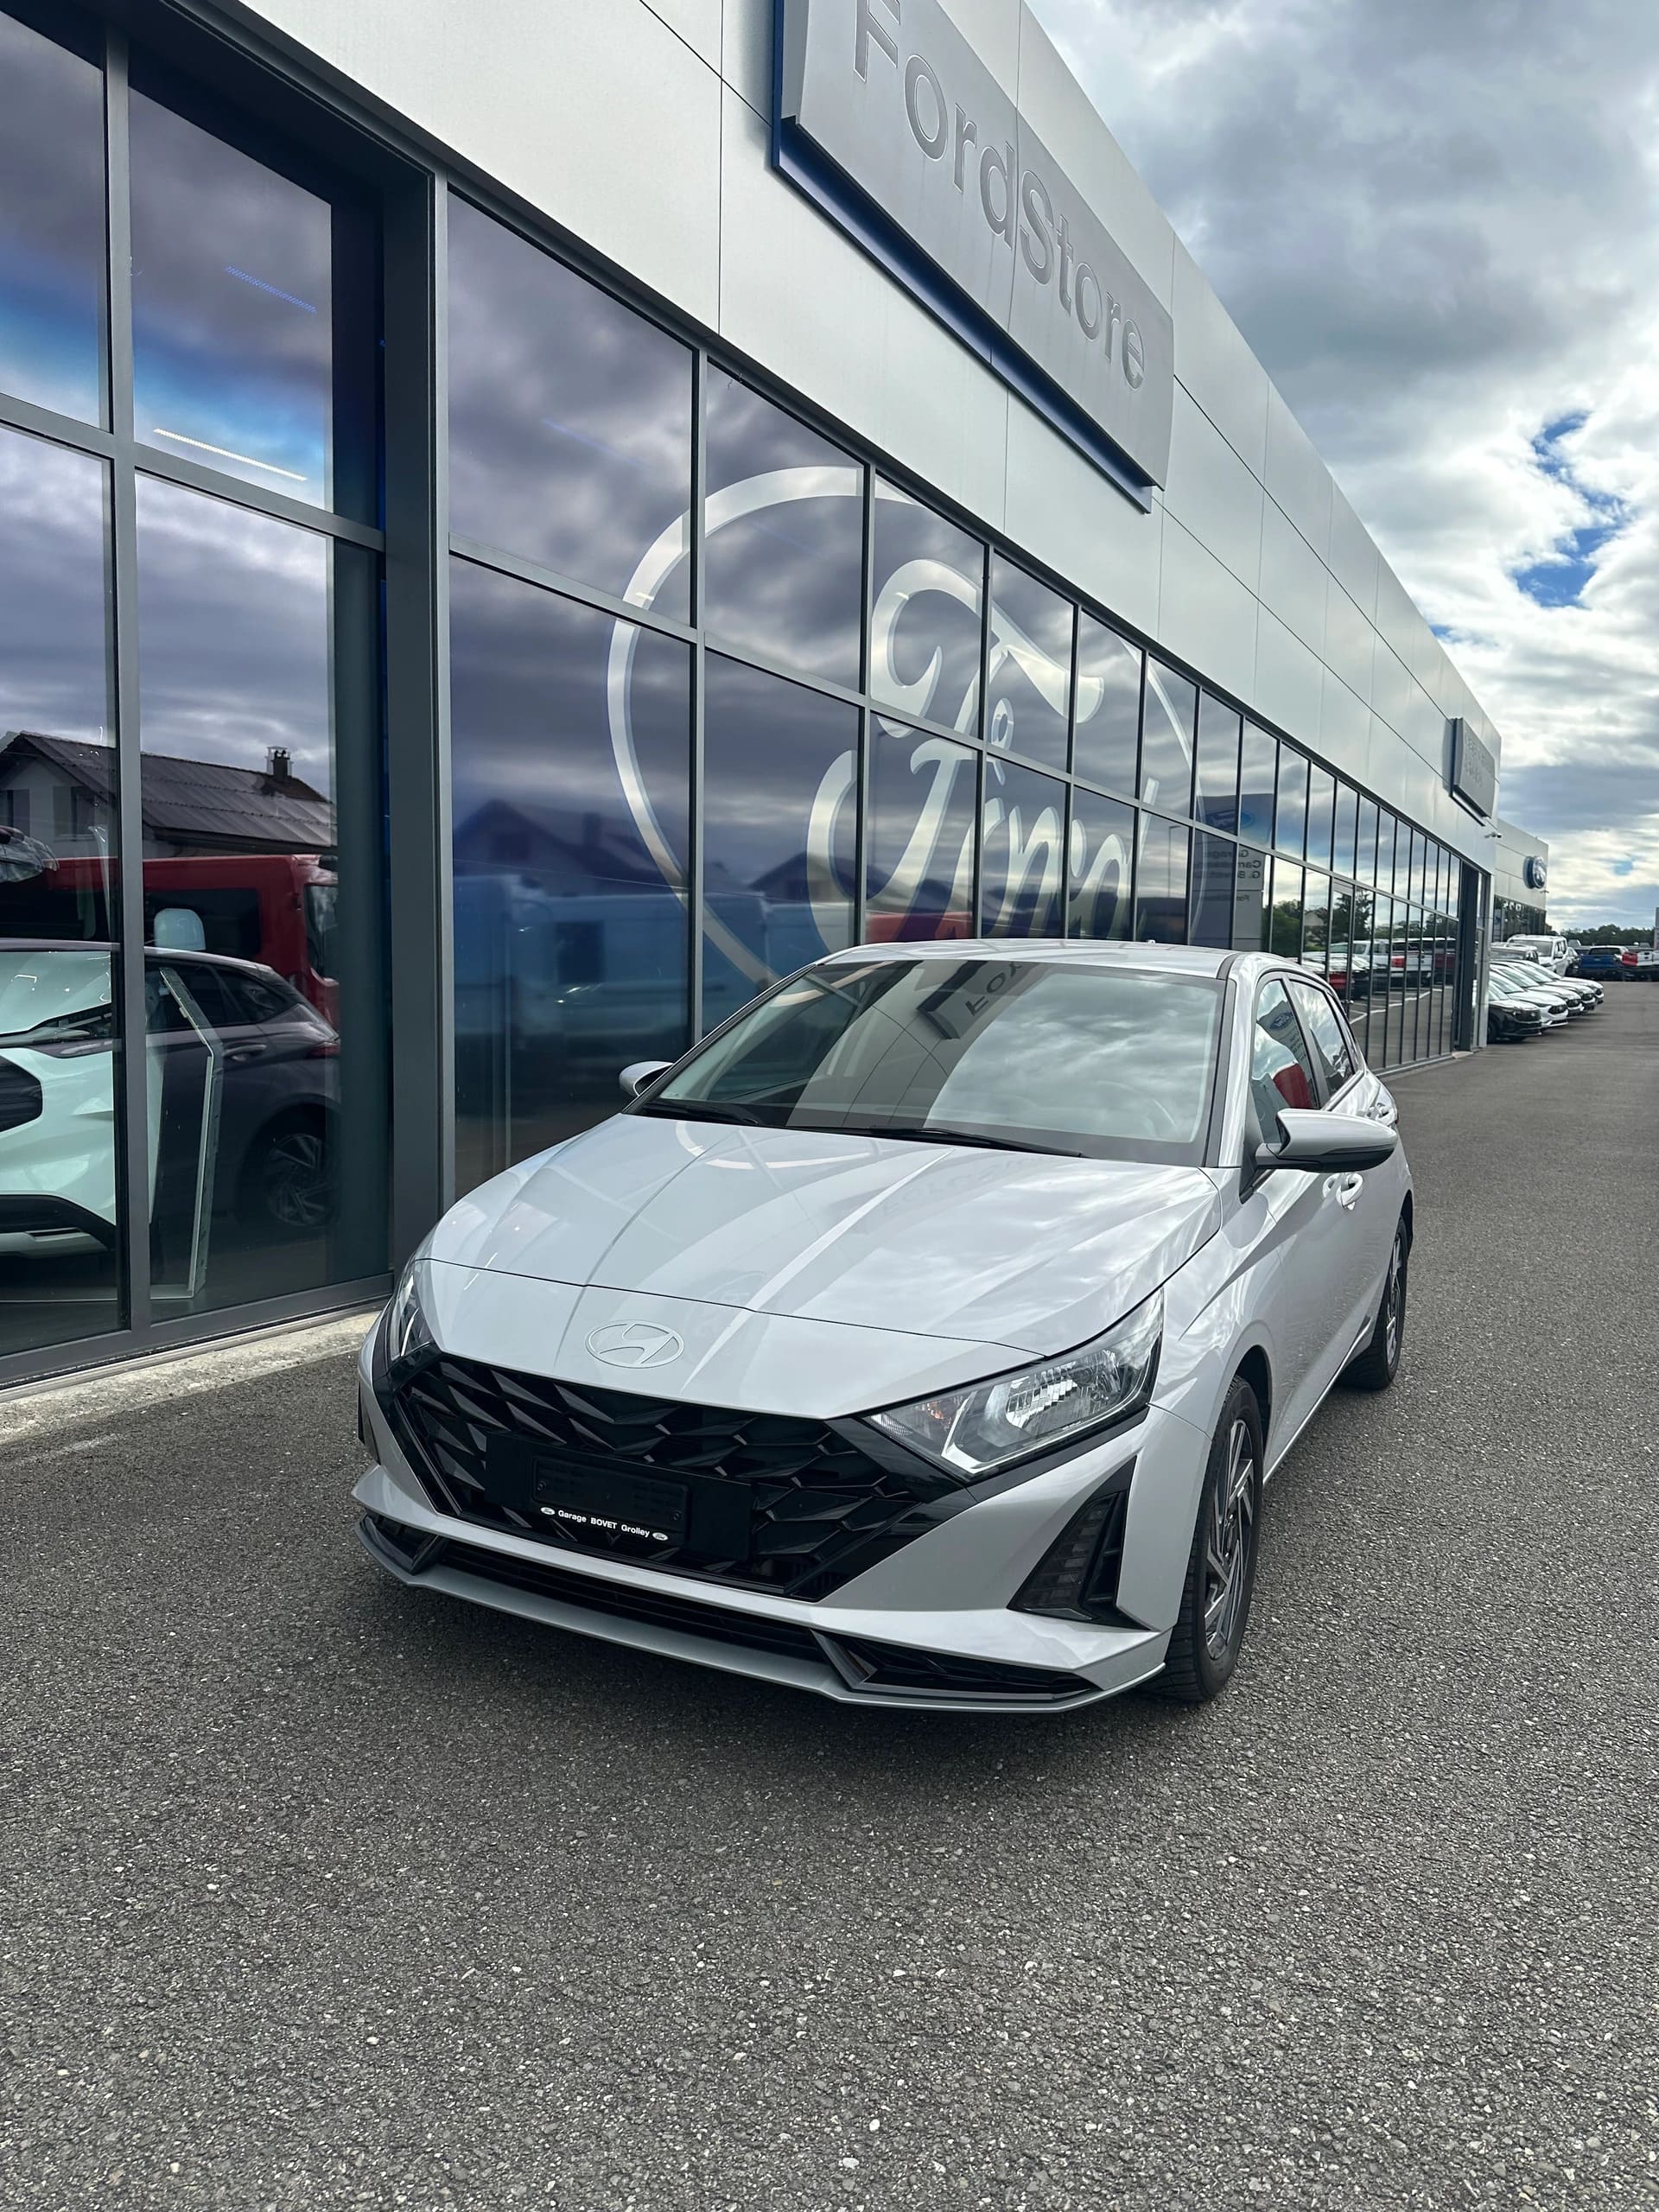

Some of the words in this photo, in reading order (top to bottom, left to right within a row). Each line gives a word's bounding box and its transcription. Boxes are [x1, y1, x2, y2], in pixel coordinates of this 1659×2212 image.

[853, 0, 1146, 391] FordStore
[557, 1510, 588, 1523] Garage
[590, 1516, 618, 1529] BOVET
[620, 1523, 651, 1539] Grolley
